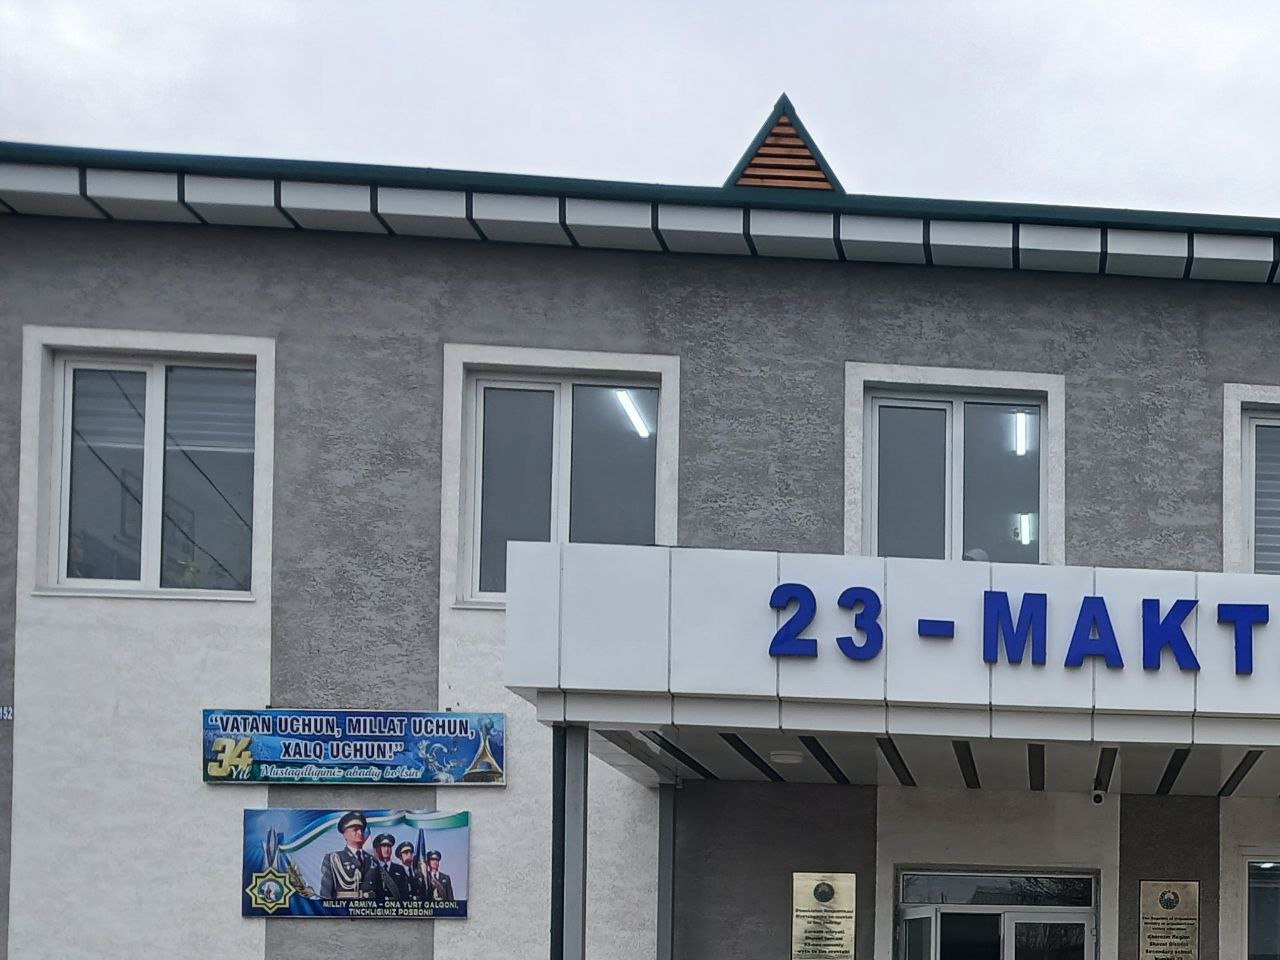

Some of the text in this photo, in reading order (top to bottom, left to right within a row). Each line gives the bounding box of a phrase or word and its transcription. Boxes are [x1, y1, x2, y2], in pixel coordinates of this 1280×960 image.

[769, 583, 884, 661] 23
[208, 715, 475, 739] “VATAN UCHUN, MILLAT UCHUN,
[207, 737, 253, 777] 34
[280, 741, 404, 761] XALQ UCHUN!”
[322, 900, 347, 908] MILLIY
[348, 900, 377, 908] ARMIYA
